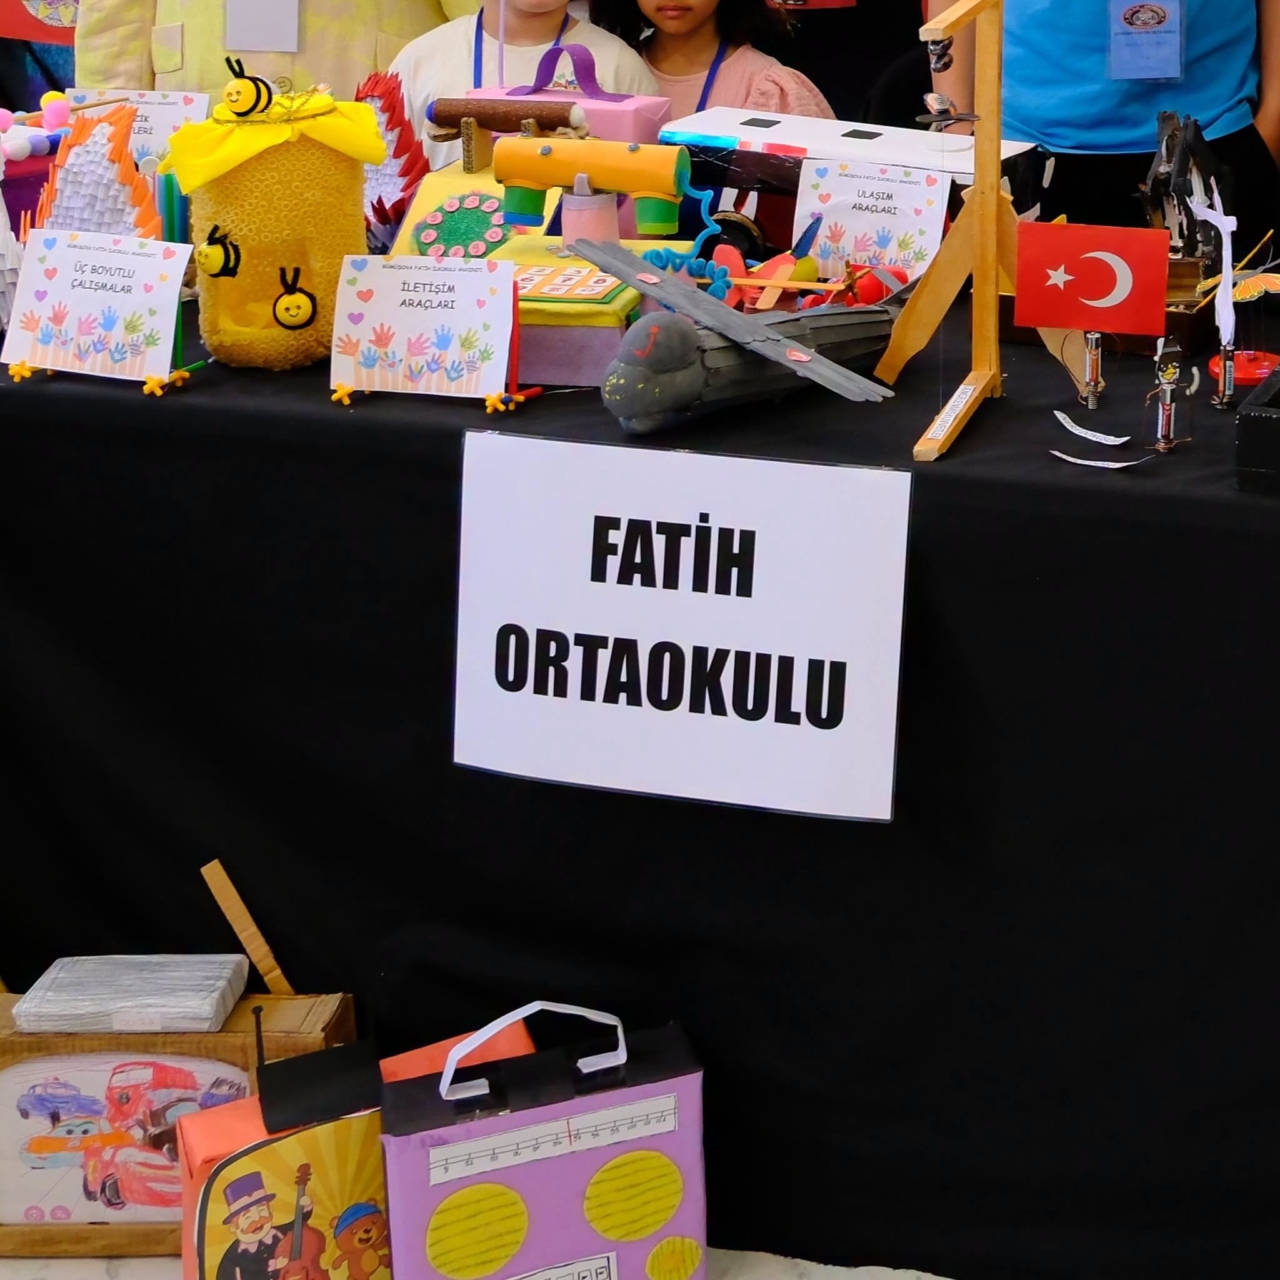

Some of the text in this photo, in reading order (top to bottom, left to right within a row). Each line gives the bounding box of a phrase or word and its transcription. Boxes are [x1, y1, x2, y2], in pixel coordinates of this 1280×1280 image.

[857, 189, 894, 202] ULAŞIM
[851, 203, 898, 216] ARAÇLARI
[74, 261, 136, 279] ÜÇ BOYUTLU
[70, 278, 133, 295] ÇALIŞMALAR
[400, 280, 456, 295] İLETİŞİM
[399, 298, 456, 310] ARAÇLARI
[590, 512, 756, 598] FATİH
[494, 623, 847, 730] ORTAOKULU
